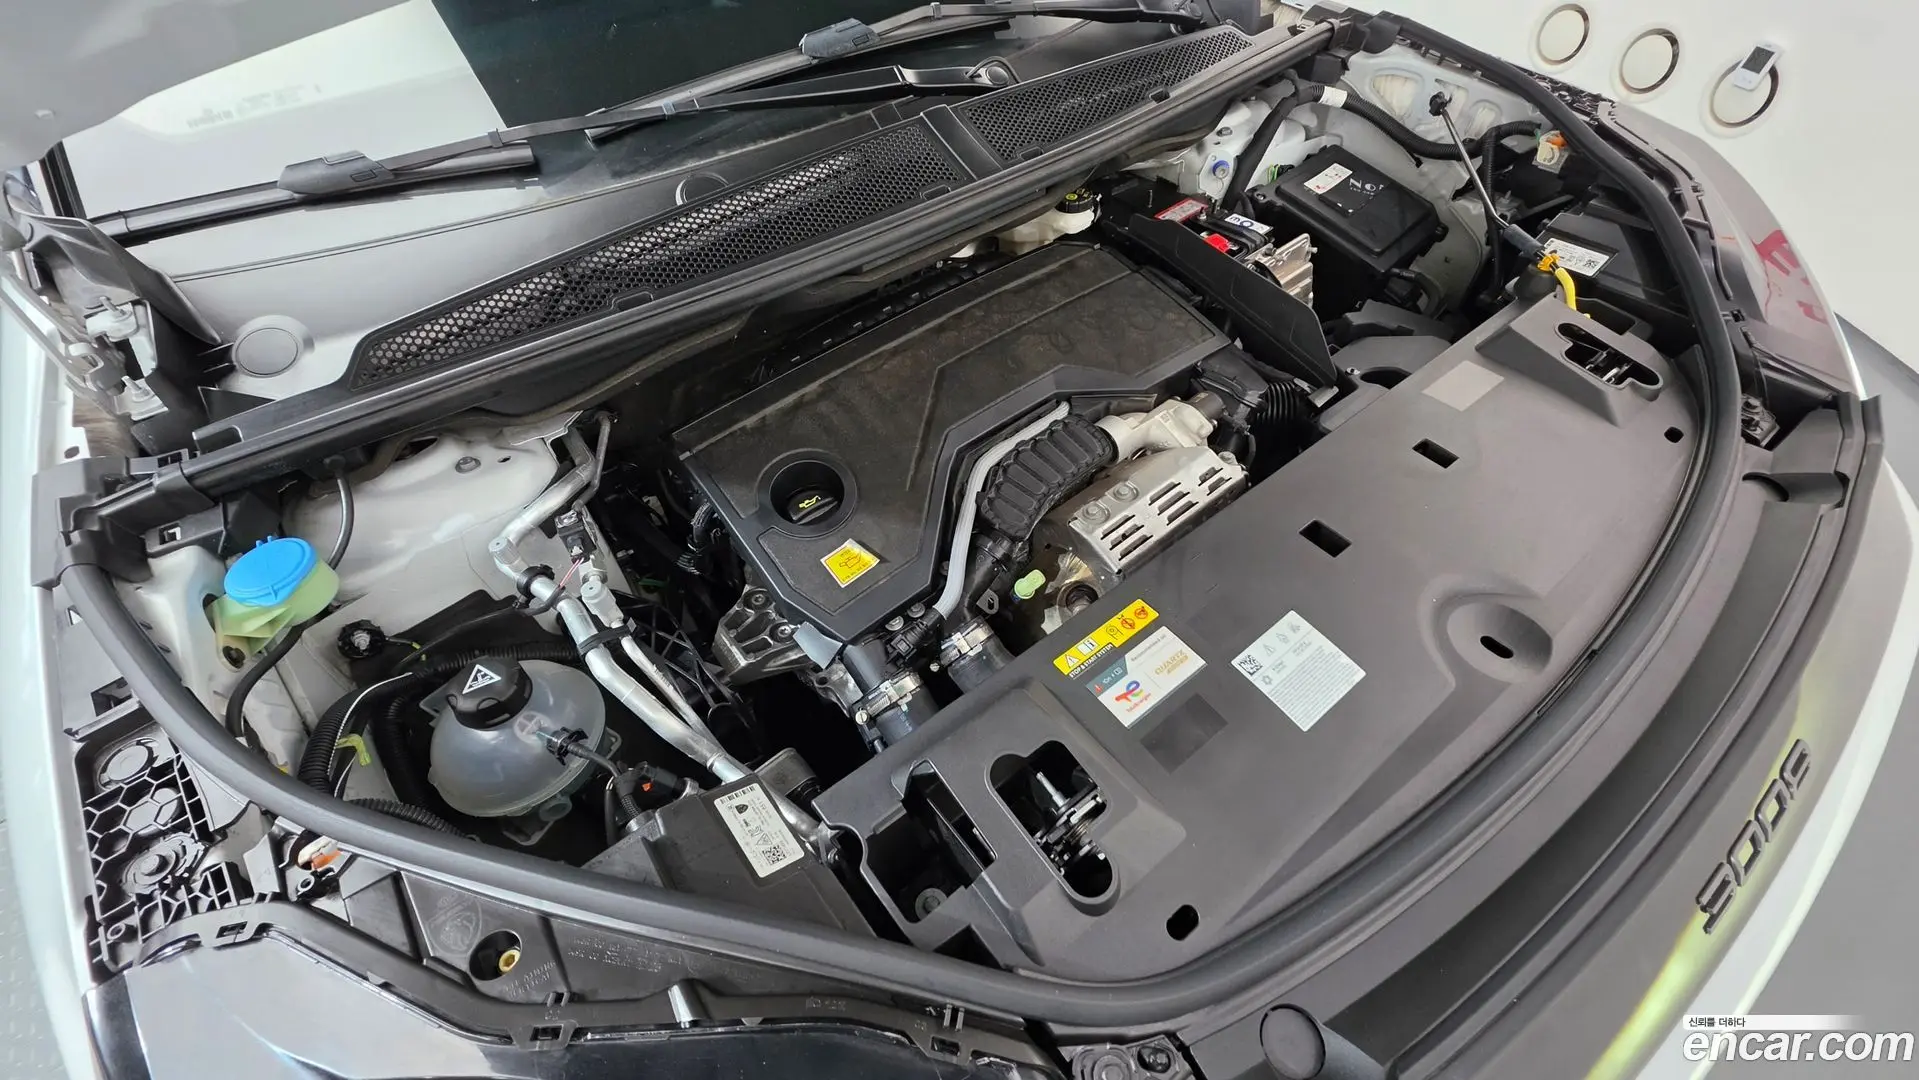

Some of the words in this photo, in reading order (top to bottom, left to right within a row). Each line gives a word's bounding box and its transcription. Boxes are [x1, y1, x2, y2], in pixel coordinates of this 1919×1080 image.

[1069, 667, 1082, 678] STOP
[1083, 655, 1098, 667] START
[1096, 643, 1113, 657] SYSTEM
